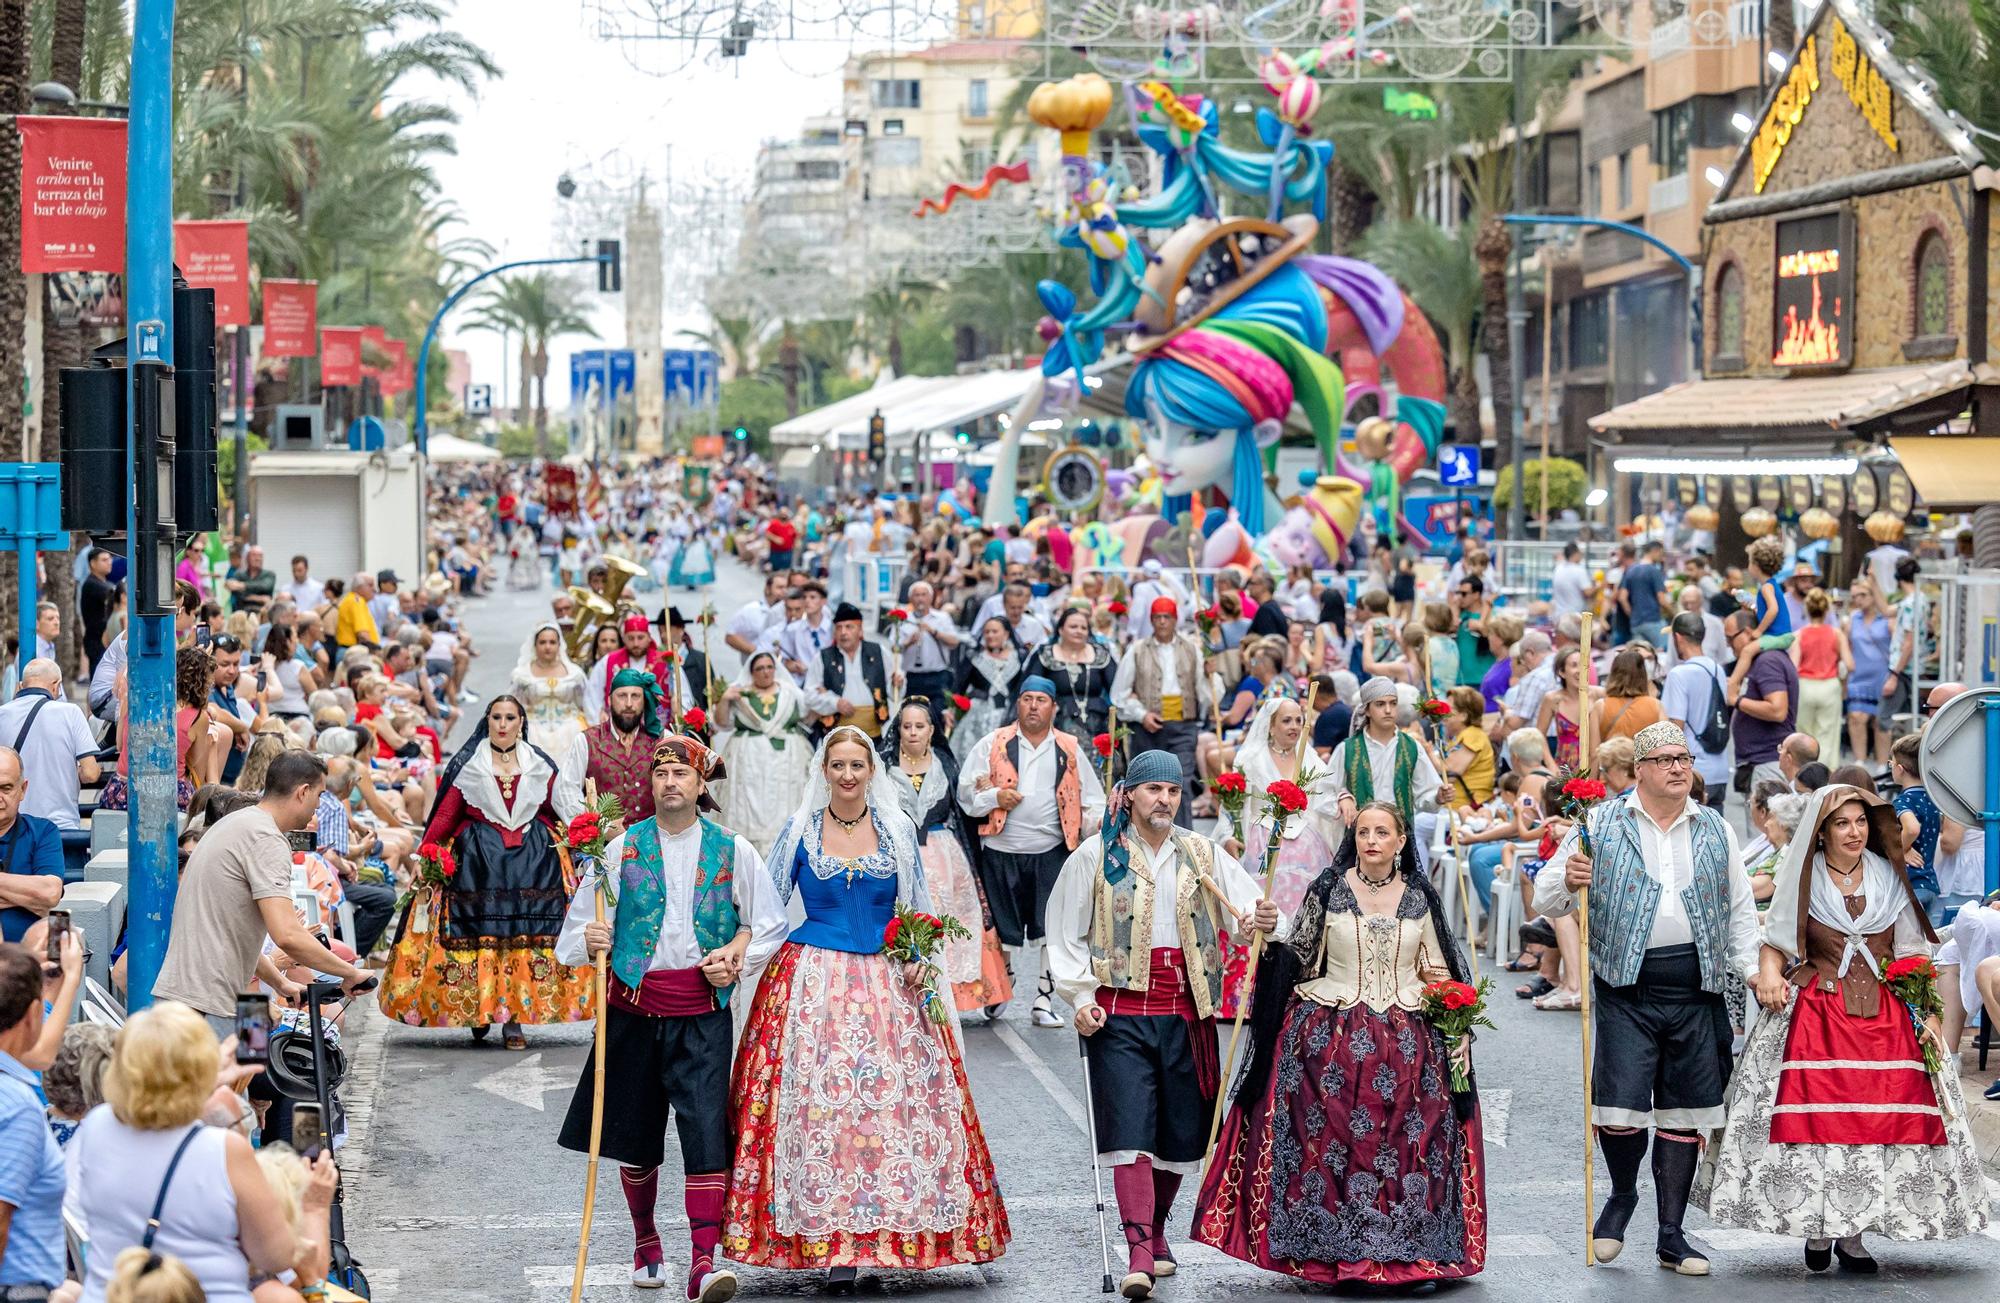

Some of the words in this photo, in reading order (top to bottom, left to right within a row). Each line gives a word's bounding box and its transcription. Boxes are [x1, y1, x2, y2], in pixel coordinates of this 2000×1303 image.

[48, 157, 93, 170] Venirte
[36, 172, 72, 185] arriba
[74, 175, 91, 185] en
[93, 172, 104, 185] la
[37, 189, 81, 200] terraza
[84, 187, 103, 200] del
[33, 202, 54, 216] bar
[57, 202, 73, 215] de
[75, 202, 107, 218] abajo
